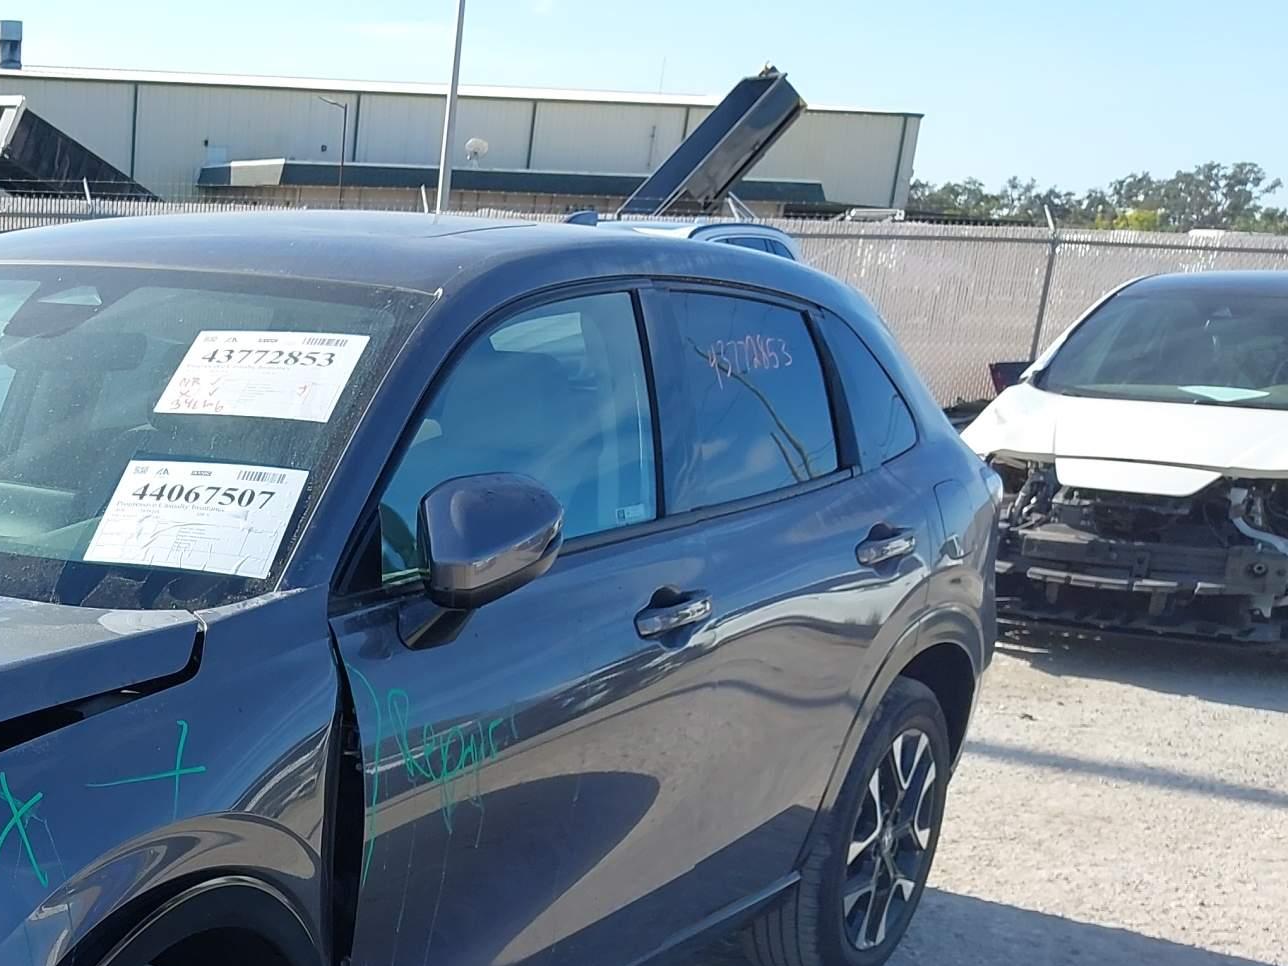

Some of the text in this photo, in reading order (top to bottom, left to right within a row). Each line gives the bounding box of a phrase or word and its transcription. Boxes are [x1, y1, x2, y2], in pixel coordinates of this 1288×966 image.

[201, 348, 336, 368] 43772853
[707, 334, 793, 391] 43772853
[131, 482, 277, 510] 44067507
